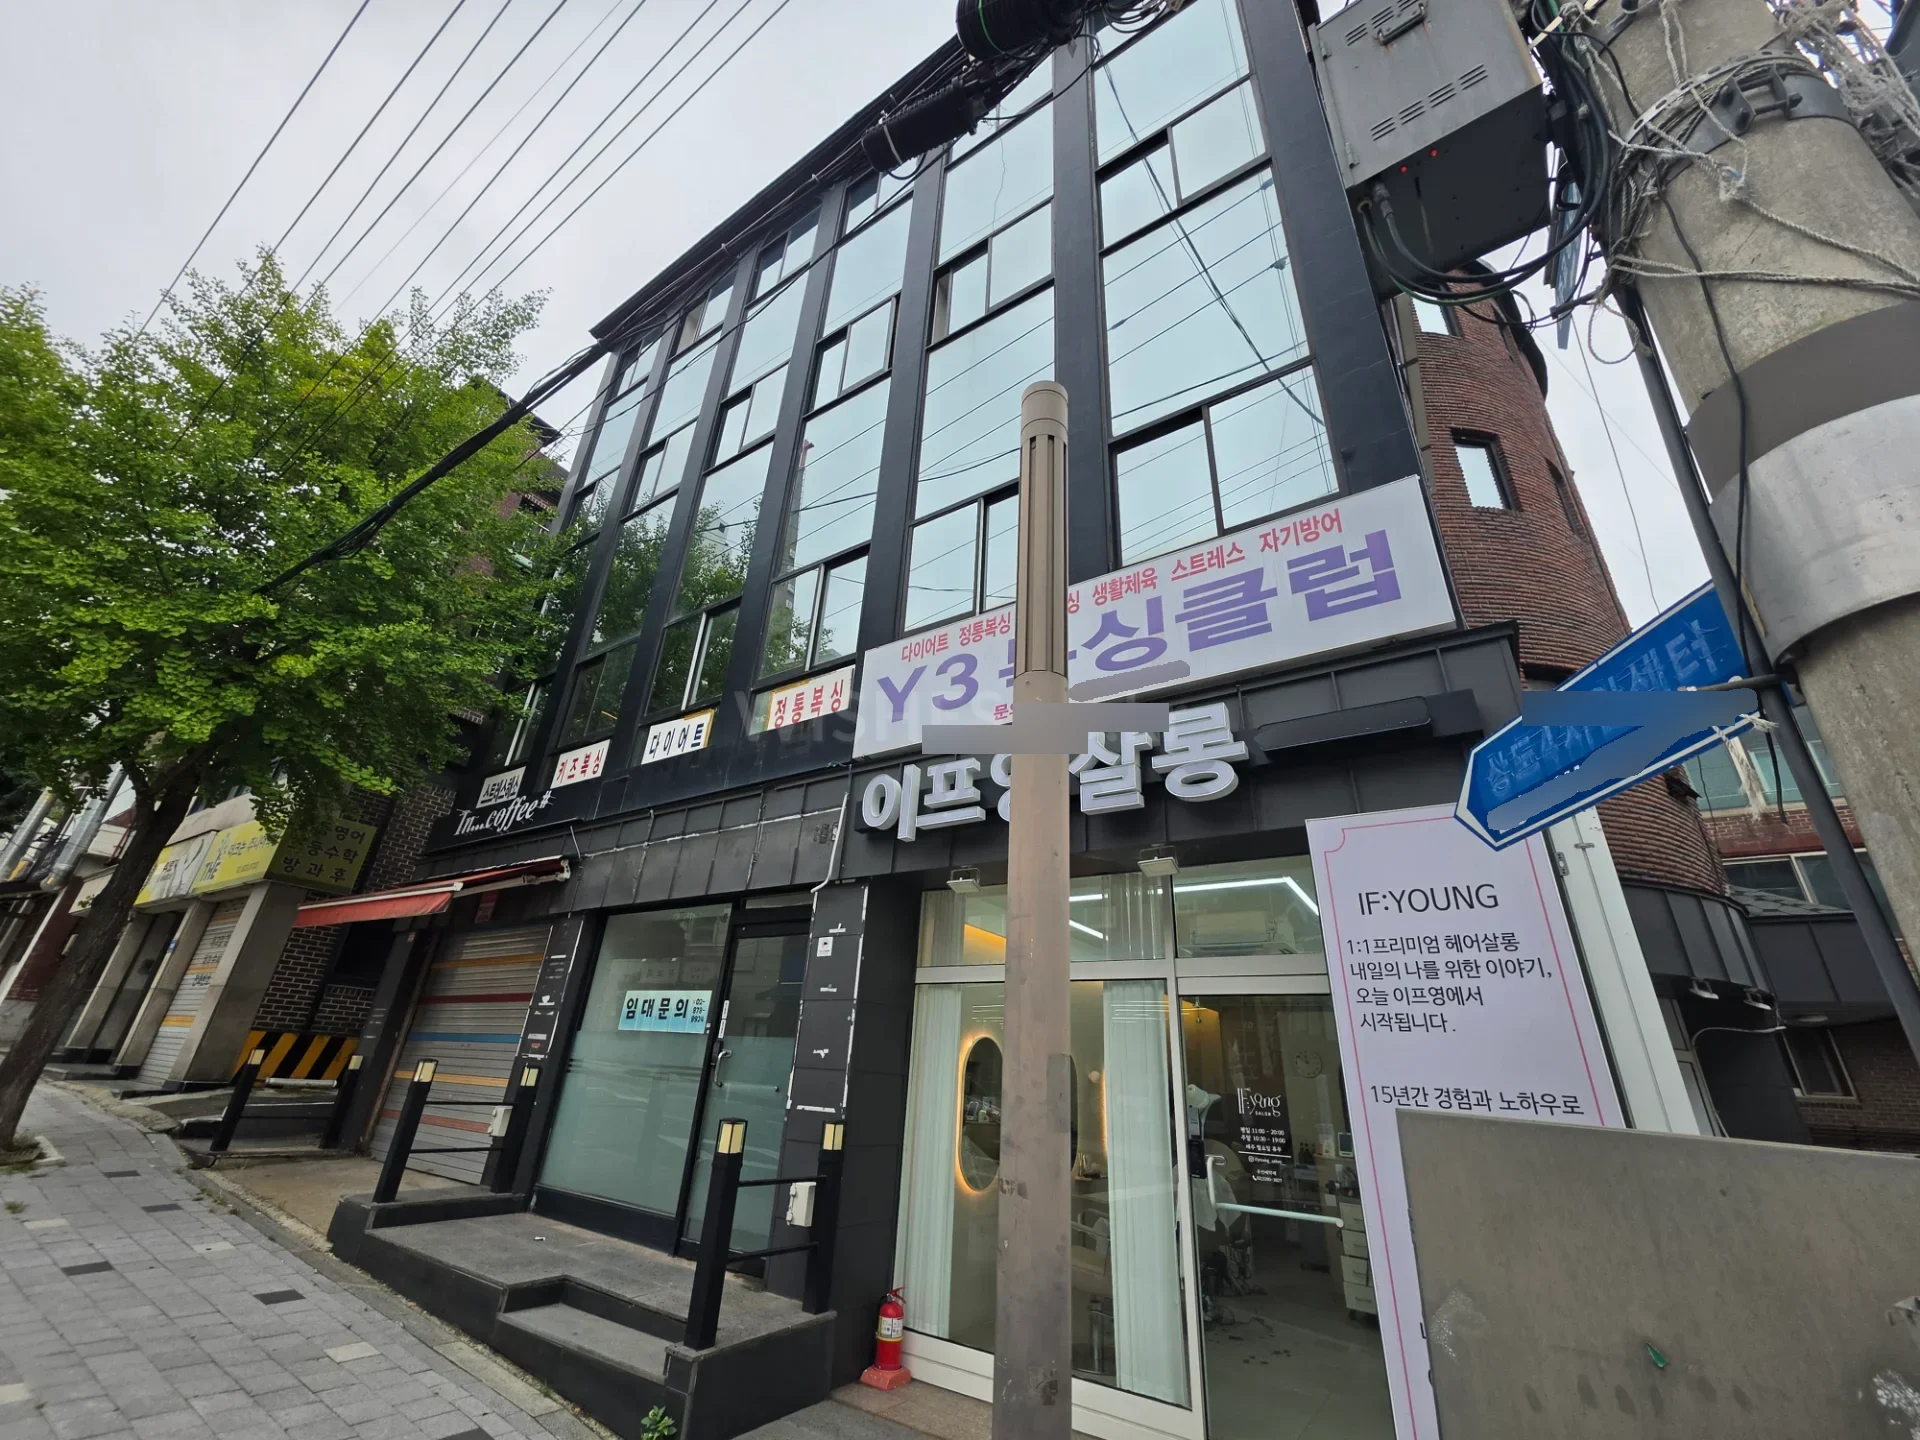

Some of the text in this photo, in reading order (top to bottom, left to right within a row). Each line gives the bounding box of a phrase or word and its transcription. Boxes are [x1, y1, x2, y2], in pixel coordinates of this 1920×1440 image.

[901, 632, 949, 662] 다이어트
[959, 611, 1012, 648] 정통복싱
[1091, 567, 1159, 606] 생활체육
[1171, 542, 1246, 582] 스트레스
[1260, 509, 1343, 553] 자기방어
[877, 529, 1401, 722] Y3싱클럽
[774, 678, 844, 729] 정통복싱
[649, 723, 704, 759] 다이어트
[556, 748, 605, 784] 키즈복싱
[1358, 883, 1500, 916] IF:YOUNG
[1346, 932, 1521, 955] 1:1프리미엄 헤어살롱
[1350, 957, 1553, 981] 내일의 나를 위한 이야기,
[626, 997, 689, 1020] 임대문의
[1356, 986, 1484, 1006] 오늘 이프영에서
[1360, 1012, 1457, 1033] 시작됩니다.
[1370, 1085, 1585, 1115] 15년간 경험과 노하우로
